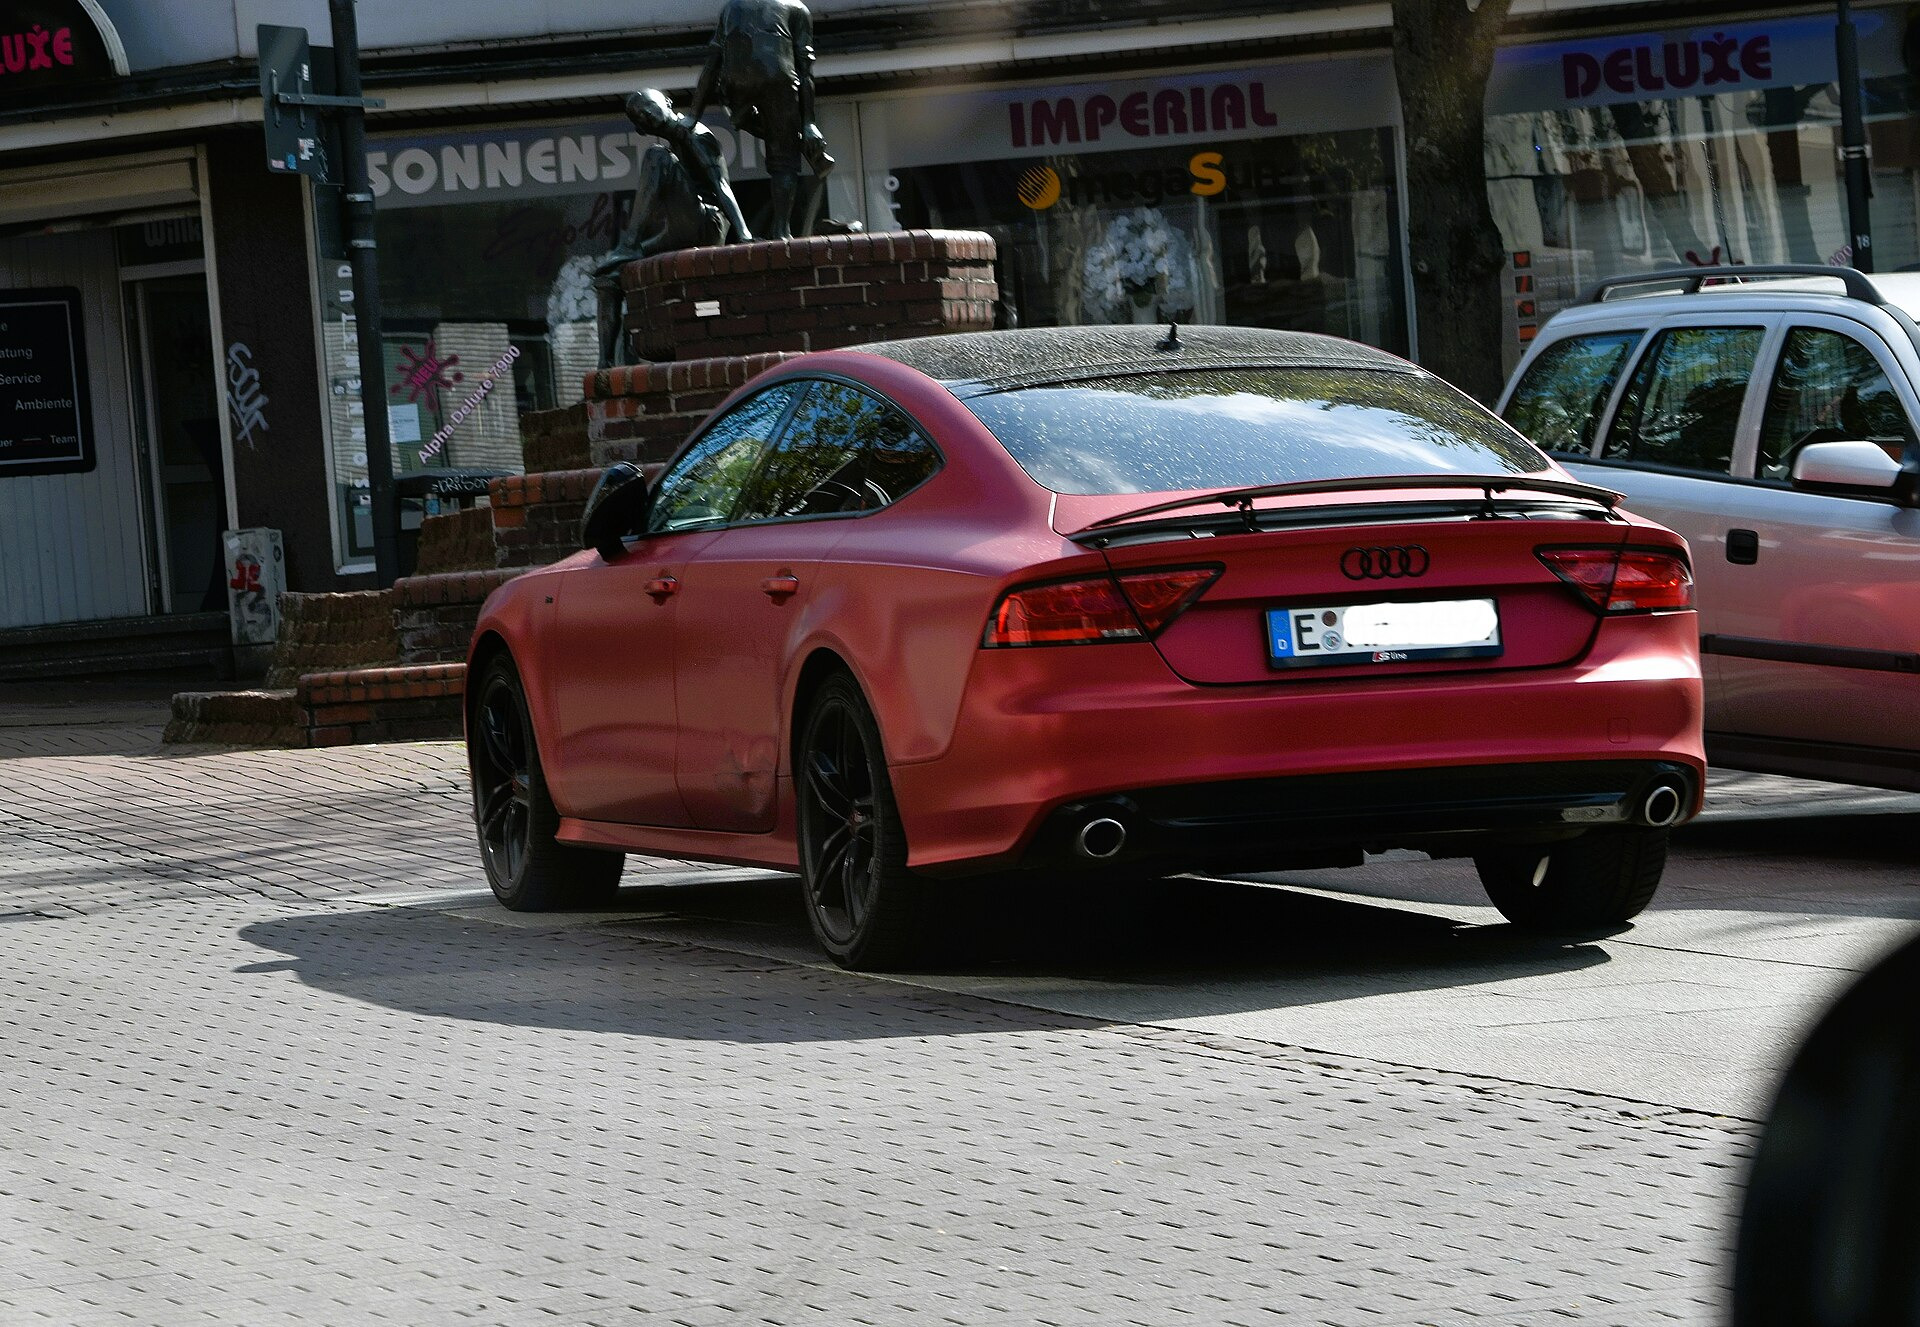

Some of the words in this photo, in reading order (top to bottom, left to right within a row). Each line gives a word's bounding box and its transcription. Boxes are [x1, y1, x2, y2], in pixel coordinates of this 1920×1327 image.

[0, 24, 75, 75] UXE
[1563, 32, 1773, 99] DELUXE
[1009, 82, 1278, 148] IMPERIAL
[15, 396, 73, 411] Ambiente
[418, 423, 455, 465] Alpha
[451, 379, 496, 425] Deluxe
[488, 345, 521, 379] 7900
[1294, 613, 1320, 651] E
